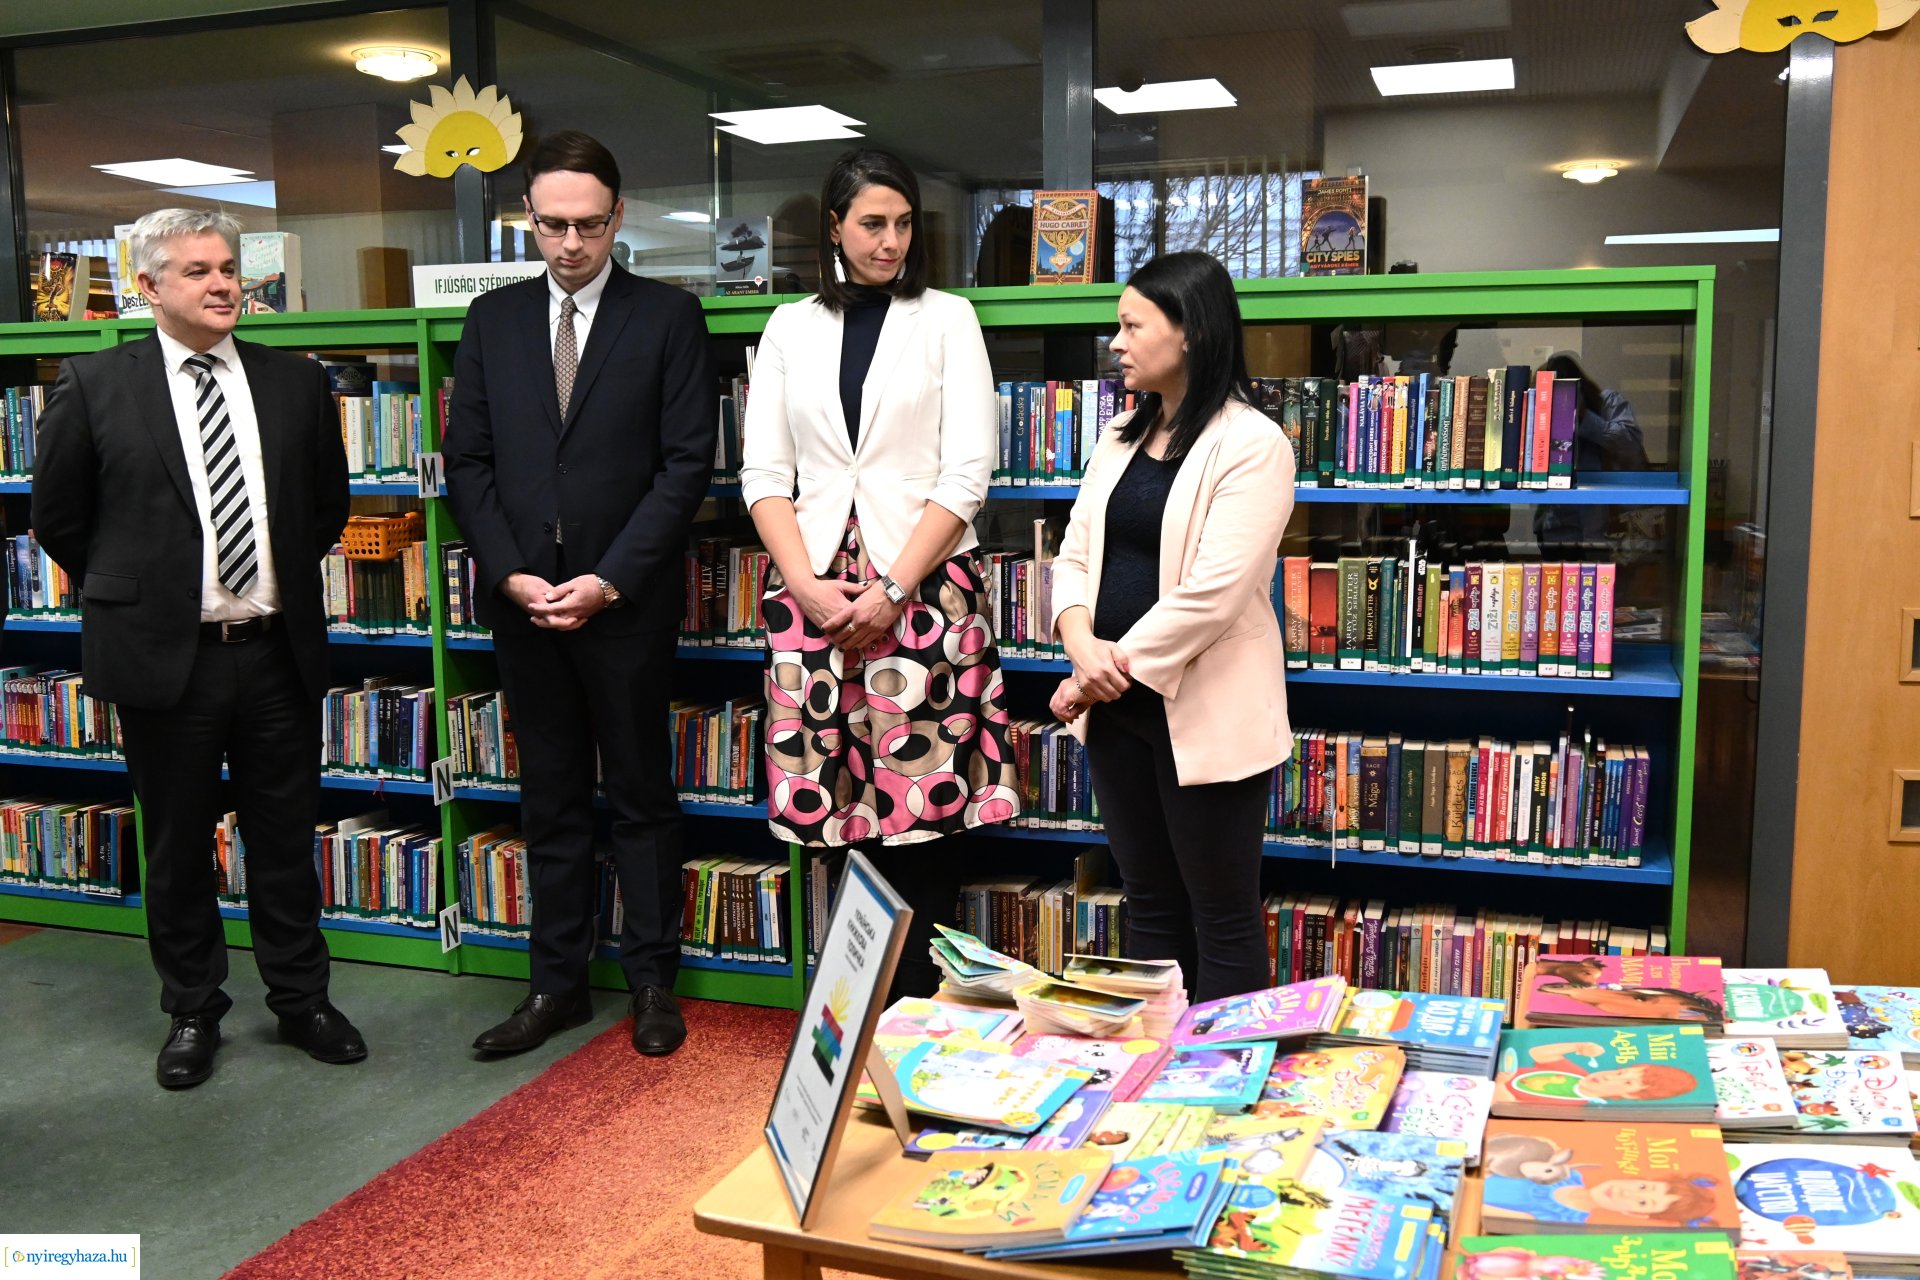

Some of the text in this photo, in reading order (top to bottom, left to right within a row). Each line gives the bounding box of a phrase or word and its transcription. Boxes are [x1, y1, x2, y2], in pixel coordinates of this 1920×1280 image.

[1061, 221, 1087, 229] CABRET
[1306, 250, 1360, 263] CITY SPIES
[434, 275, 476, 294] IFJÚSÁGI
[422, 457, 437, 493] M
[701, 565, 713, 600] ATTILA
[715, 561, 728, 598] ATTILA
[1346, 573, 1354, 616] POTTER
[1366, 594, 1374, 641] HARRY POTTER
[436, 763, 451, 801] N
[1368, 782, 1380, 808] Mágia
[1499, 757, 1510, 816] Bambi gyermekei
[1539, 772, 1547, 797] SÁNDOR
[1451, 779, 1464, 828] Küldetés
[444, 910, 459, 949] N
[1645, 1137, 1681, 1171] Мої
